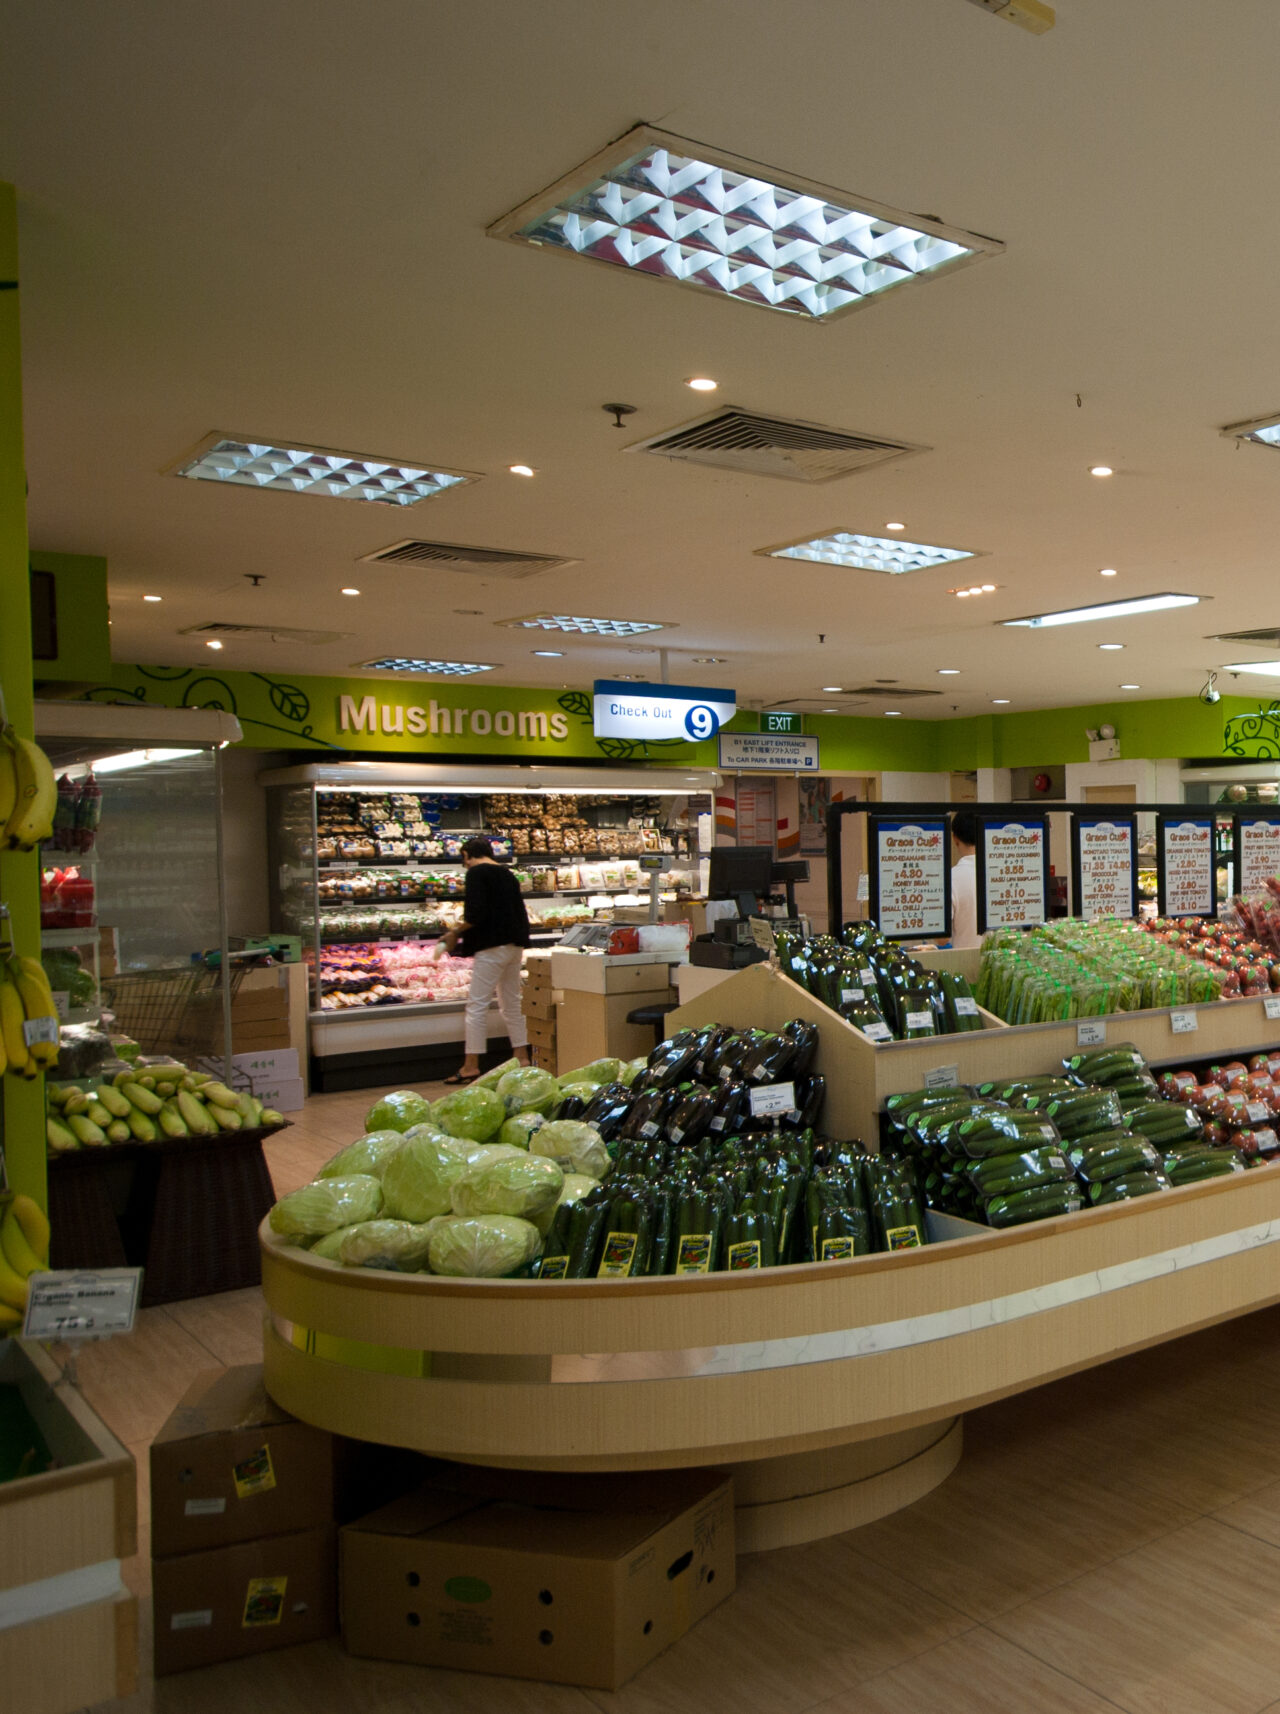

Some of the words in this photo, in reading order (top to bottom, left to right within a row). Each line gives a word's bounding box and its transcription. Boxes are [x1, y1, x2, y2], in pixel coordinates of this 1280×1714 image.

[339, 694, 569, 739] Mushrooms
[610, 703, 648, 717] Check
[653, 706, 672, 719] Out
[690, 706, 713, 739] 9
[768, 716, 792, 731] EXIT
[775, 740, 807, 748] ENTRANCE
[886, 836, 914, 848] Grace
[991, 835, 1017, 846] Grace
[77, 1289, 116, 1298] Banana
